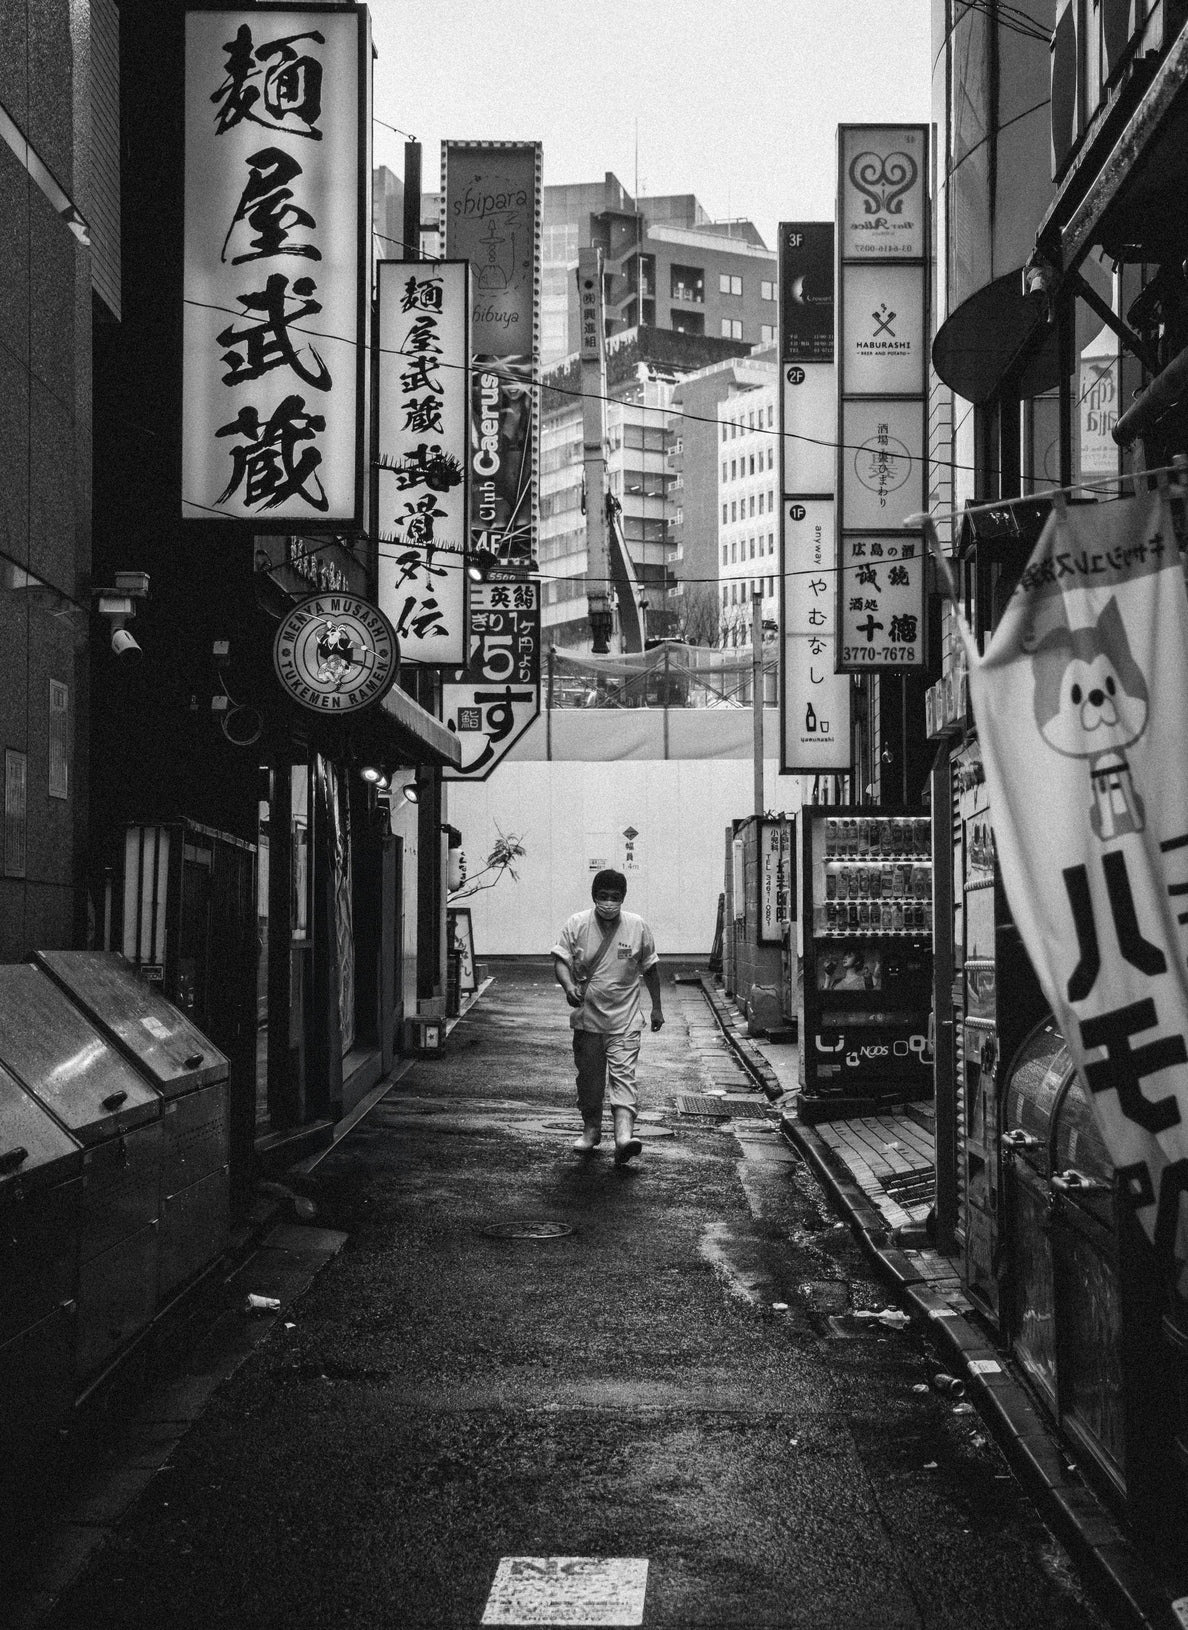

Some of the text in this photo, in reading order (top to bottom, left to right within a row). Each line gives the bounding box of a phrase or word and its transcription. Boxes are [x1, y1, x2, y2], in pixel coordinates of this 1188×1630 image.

[788, 233, 803, 247] 3F
[210, 23, 332, 512] 麺屋武蔵
[472, 304, 519, 329] hibuya
[789, 370, 804, 384] 2F
[473, 372, 500, 520] Club Caerus
[790, 506, 805, 519] 1F
[812, 525, 822, 565] anyway
[852, 543, 915, 557] 広島の酒
[849, 597, 879, 611] 酒処
[331, 599, 388, 643] MUSASHI
[807, 578, 828, 684] やむなし
[843, 646, 915, 661] 3770-7678
[281, 660, 389, 709] TUKEMEN RAMEN
